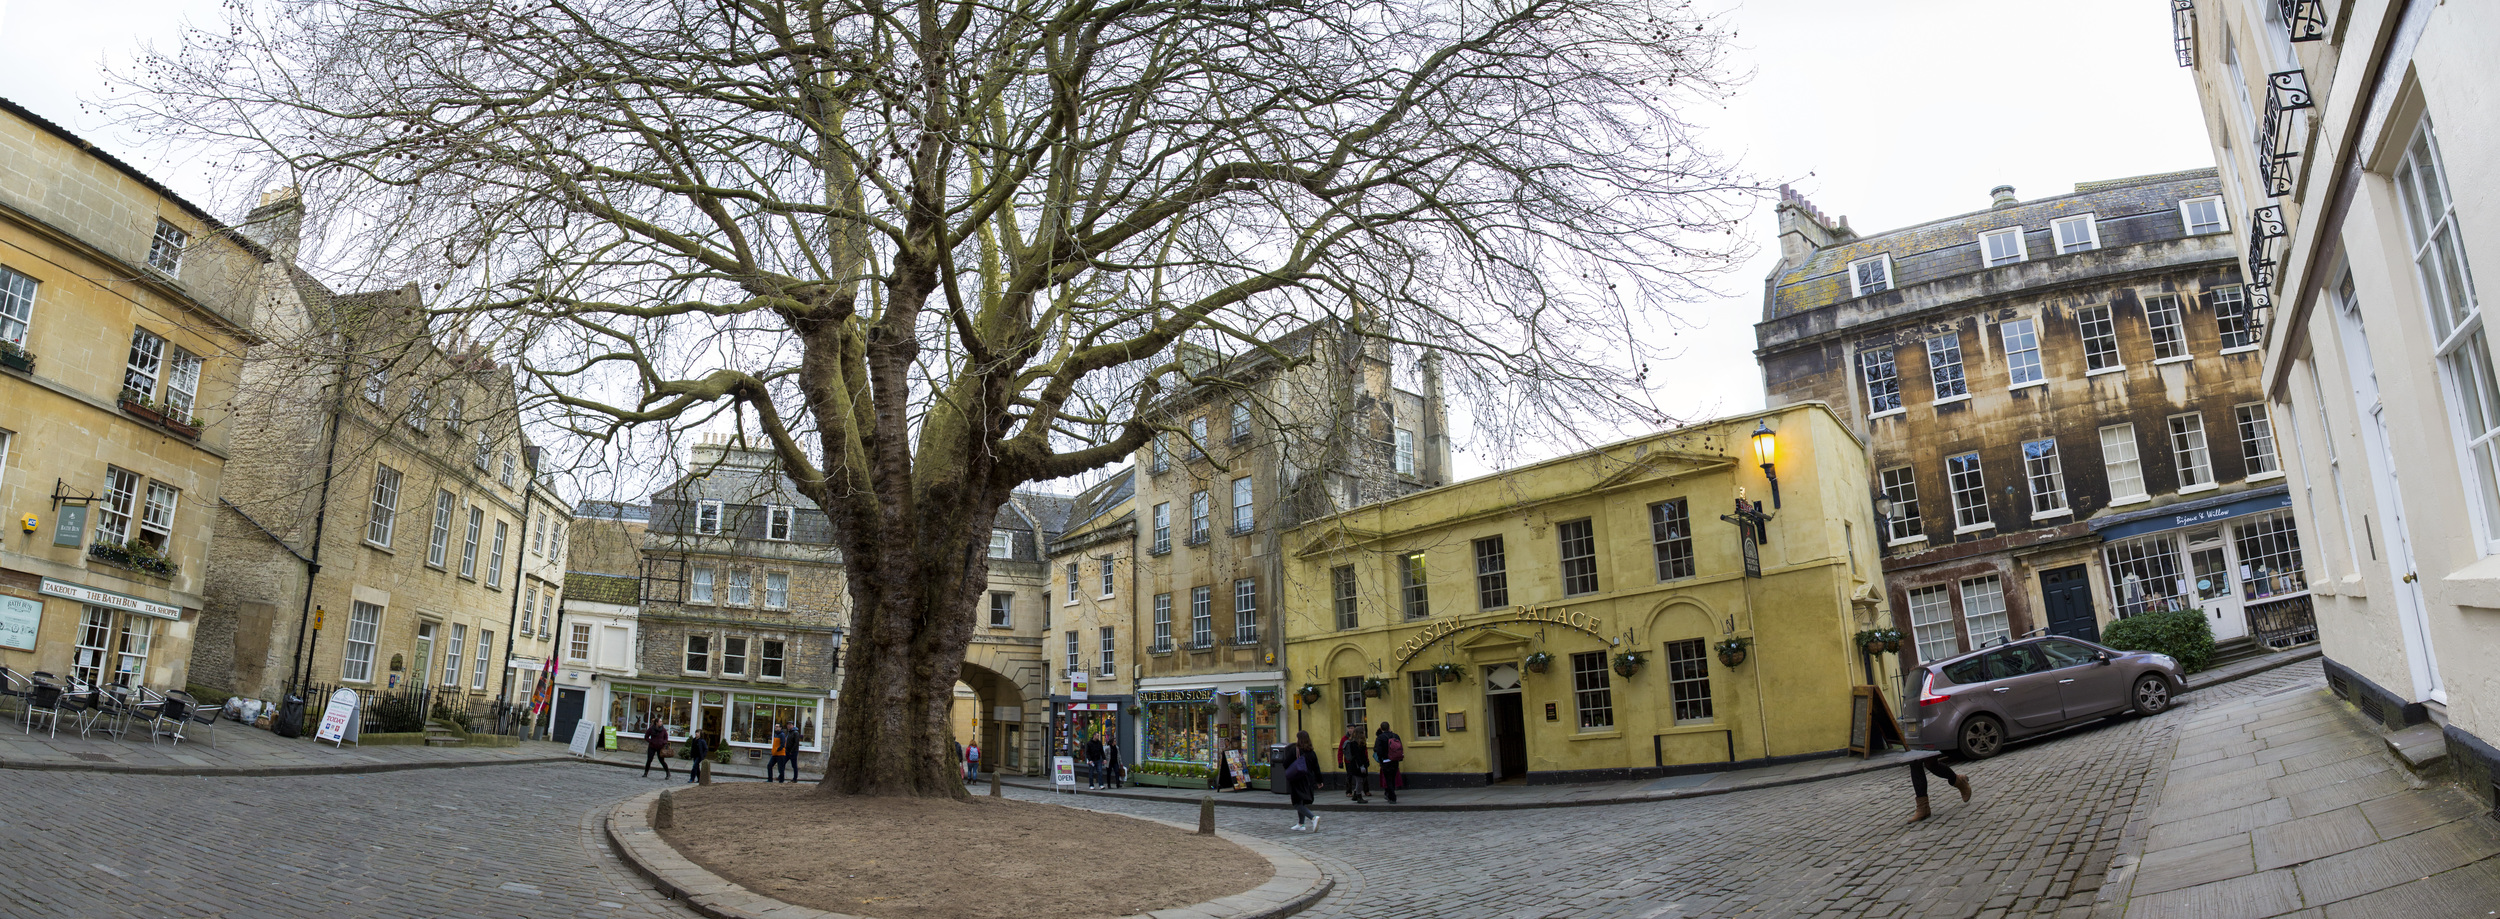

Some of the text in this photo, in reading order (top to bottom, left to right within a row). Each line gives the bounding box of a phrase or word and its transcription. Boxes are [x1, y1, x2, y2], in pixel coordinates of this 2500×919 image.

[2176, 509, 2230, 525] Bijoux & Willow
[44, 583, 77, 596] TAKEOUT
[86, 591, 138, 608] THE BATH BUN
[145, 604, 178, 617] TEA SHOPPE
[1395, 604, 1601, 662] CRYSTAL PALACE
[1140, 690, 1212, 700] BATH RETRO STORE
[327, 716, 345, 724] TODAY
[1057, 774, 1073, 782] OPEN
